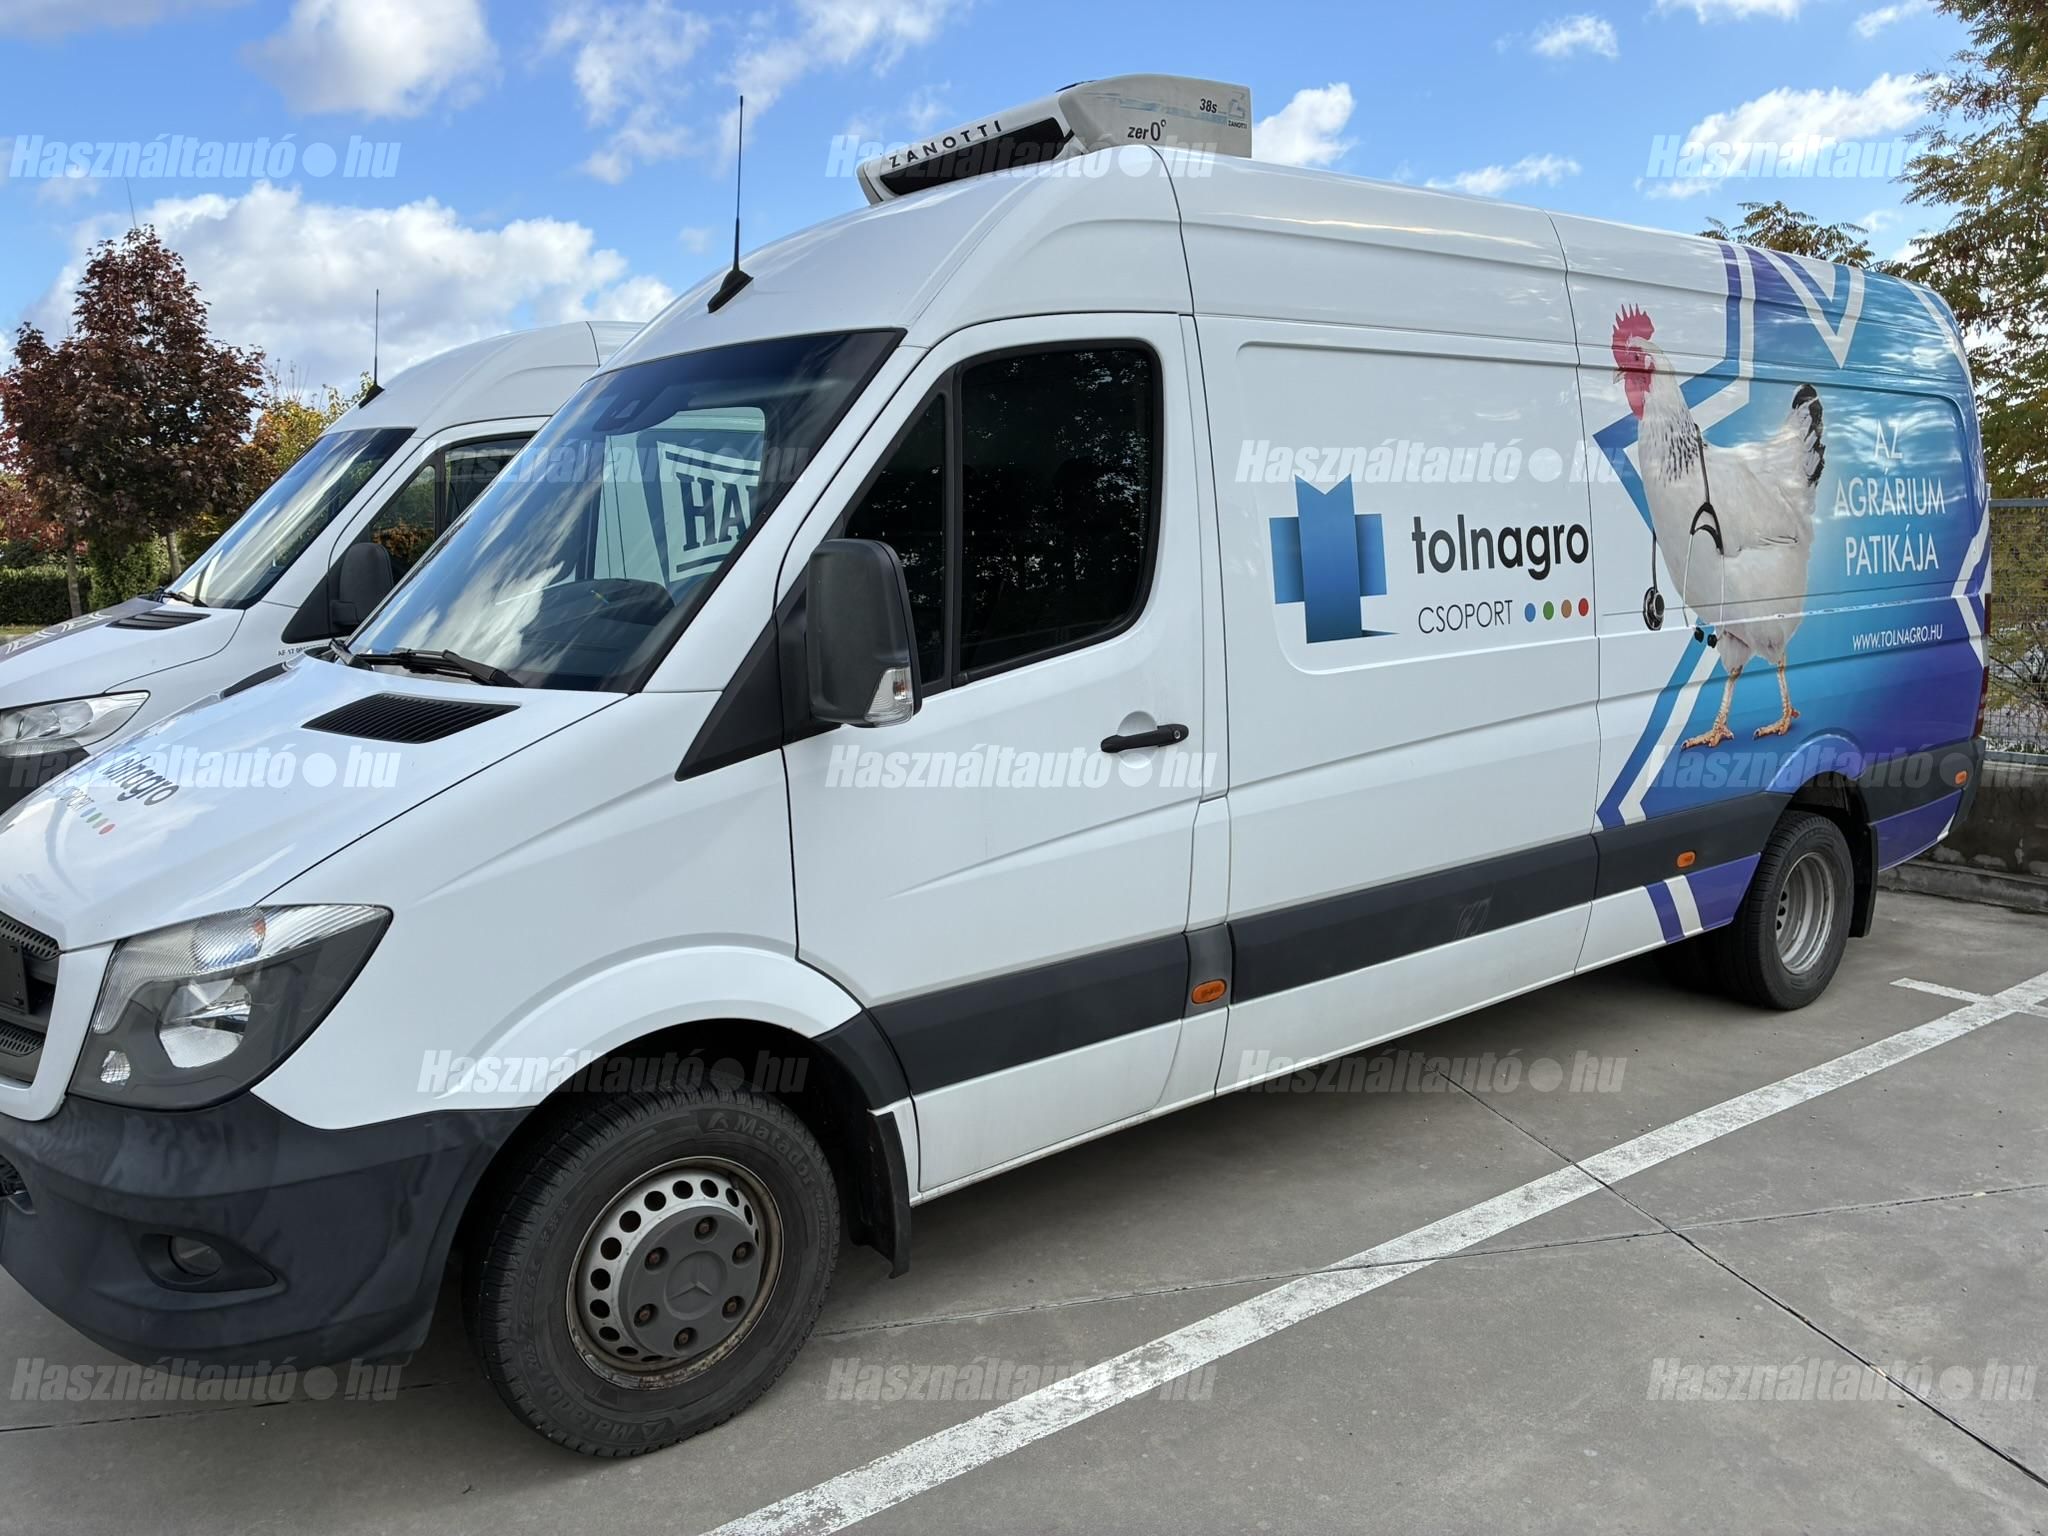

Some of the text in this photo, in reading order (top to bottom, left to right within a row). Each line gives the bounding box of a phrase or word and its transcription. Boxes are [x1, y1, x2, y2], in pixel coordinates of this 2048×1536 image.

[1199, 97, 1218, 114] 38s
[889, 119, 1003, 168] ZANOTTI
[1873, 418, 1904, 460] AZ
[1833, 467, 1946, 518] AGRÁRIUM
[1411, 513, 1589, 581] tolnagro
[1845, 523, 1939, 577] PATIKÁJA
[1418, 599, 1513, 634] CSOPORT
[1852, 623, 1943, 651] WWW.TOLNAGRO.HU
